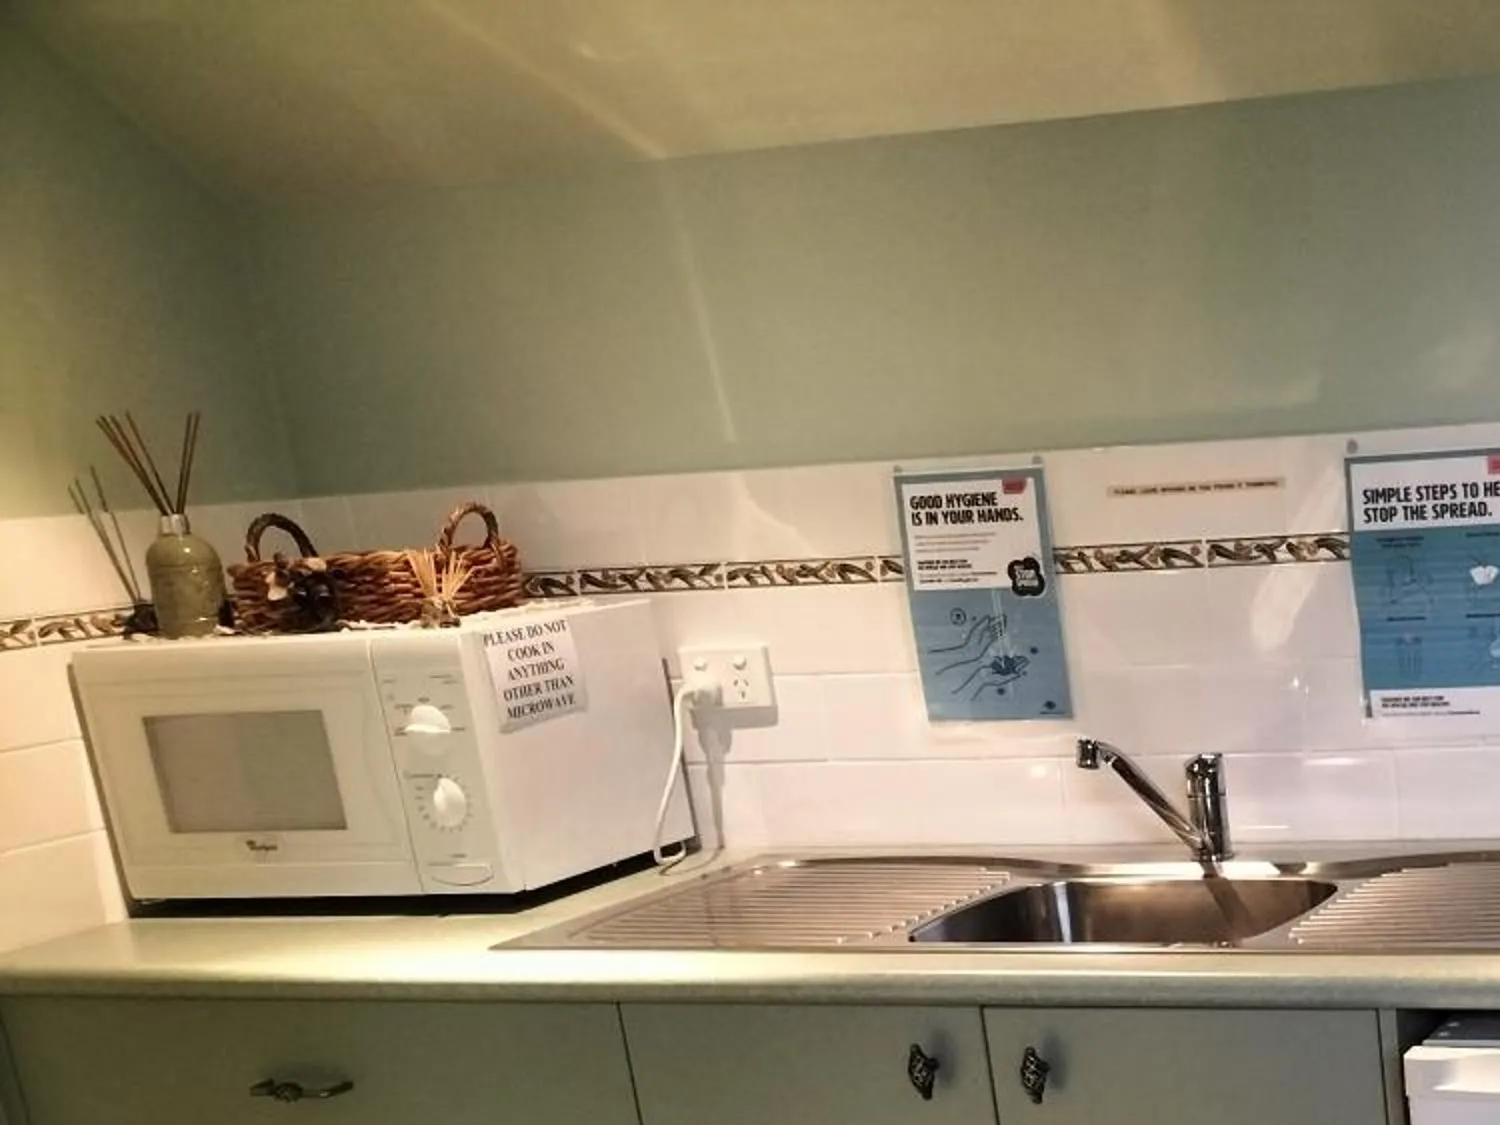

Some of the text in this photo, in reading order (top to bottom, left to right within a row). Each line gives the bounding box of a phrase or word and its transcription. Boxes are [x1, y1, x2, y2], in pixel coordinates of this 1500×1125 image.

[910, 492, 998, 510] GOOD HYGIENE
[1363, 486, 1413, 504] SIMPLE
[1416, 484, 1457, 502] STEPS
[1462, 482, 1480, 498] TO
[912, 507, 1024, 526] IS IN YOUR HANDS.
[1364, 502, 1493, 524] STOP THE SPREAD.
[483, 619, 568, 648] PLEASE DO NOT
[507, 641, 556, 662] COOK IN
[509, 658, 565, 681] ANYTHING
[503, 675, 574, 703] OTHER THAN
[507, 693, 575, 719] MICROWAVE
